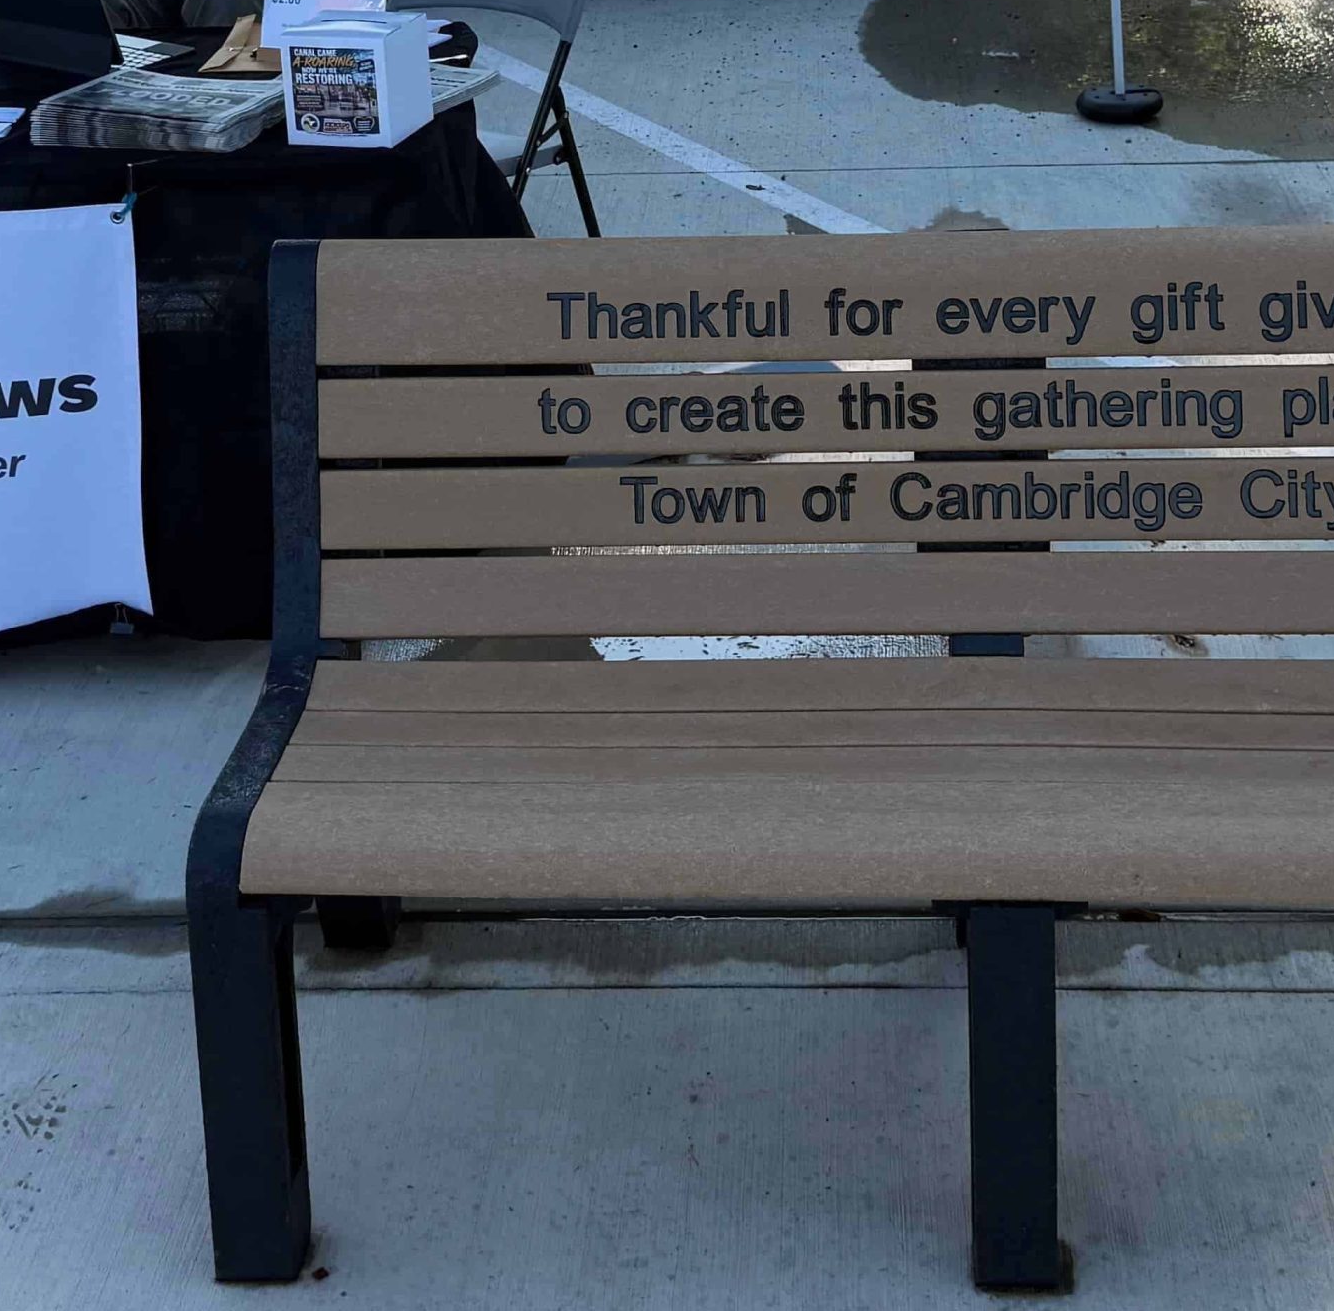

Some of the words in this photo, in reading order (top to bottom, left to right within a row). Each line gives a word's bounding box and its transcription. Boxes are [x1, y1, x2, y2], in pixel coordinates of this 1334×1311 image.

[295, 73, 353, 85] RESTORING
[546, 288, 790, 340] Thankful
[823, 287, 904, 337] for
[935, 295, 1097, 346] every
[1130, 281, 1226, 345] gift
[537, 387, 592, 435] to
[625, 384, 805, 434] create
[837, 381, 939, 431] this
[972, 377, 1244, 442] gathering
[619, 475, 766, 525] Town
[801, 472, 858, 523] of
[889, 470, 1203, 533] Cambridge
